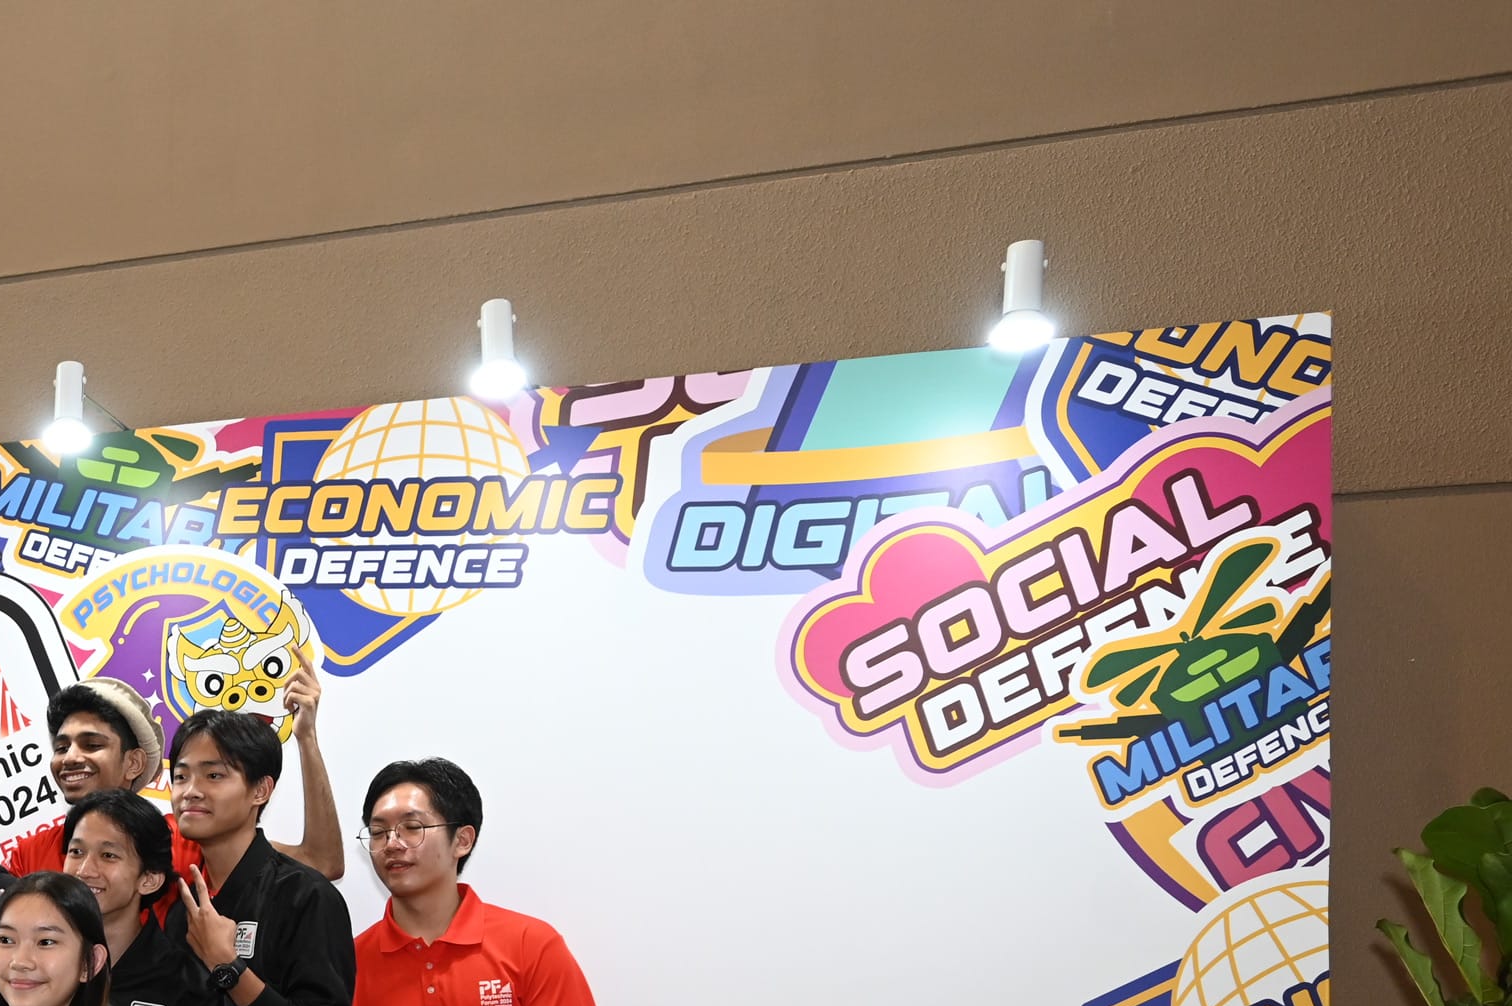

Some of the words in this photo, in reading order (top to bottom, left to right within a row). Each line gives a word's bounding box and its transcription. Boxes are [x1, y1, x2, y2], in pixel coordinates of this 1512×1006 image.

[216, 477, 619, 535] ECONOMIC
[280, 545, 525, 586] DEFENCE
[844, 474, 1253, 715] SOCIAL
[478, 979, 501, 995] PF
